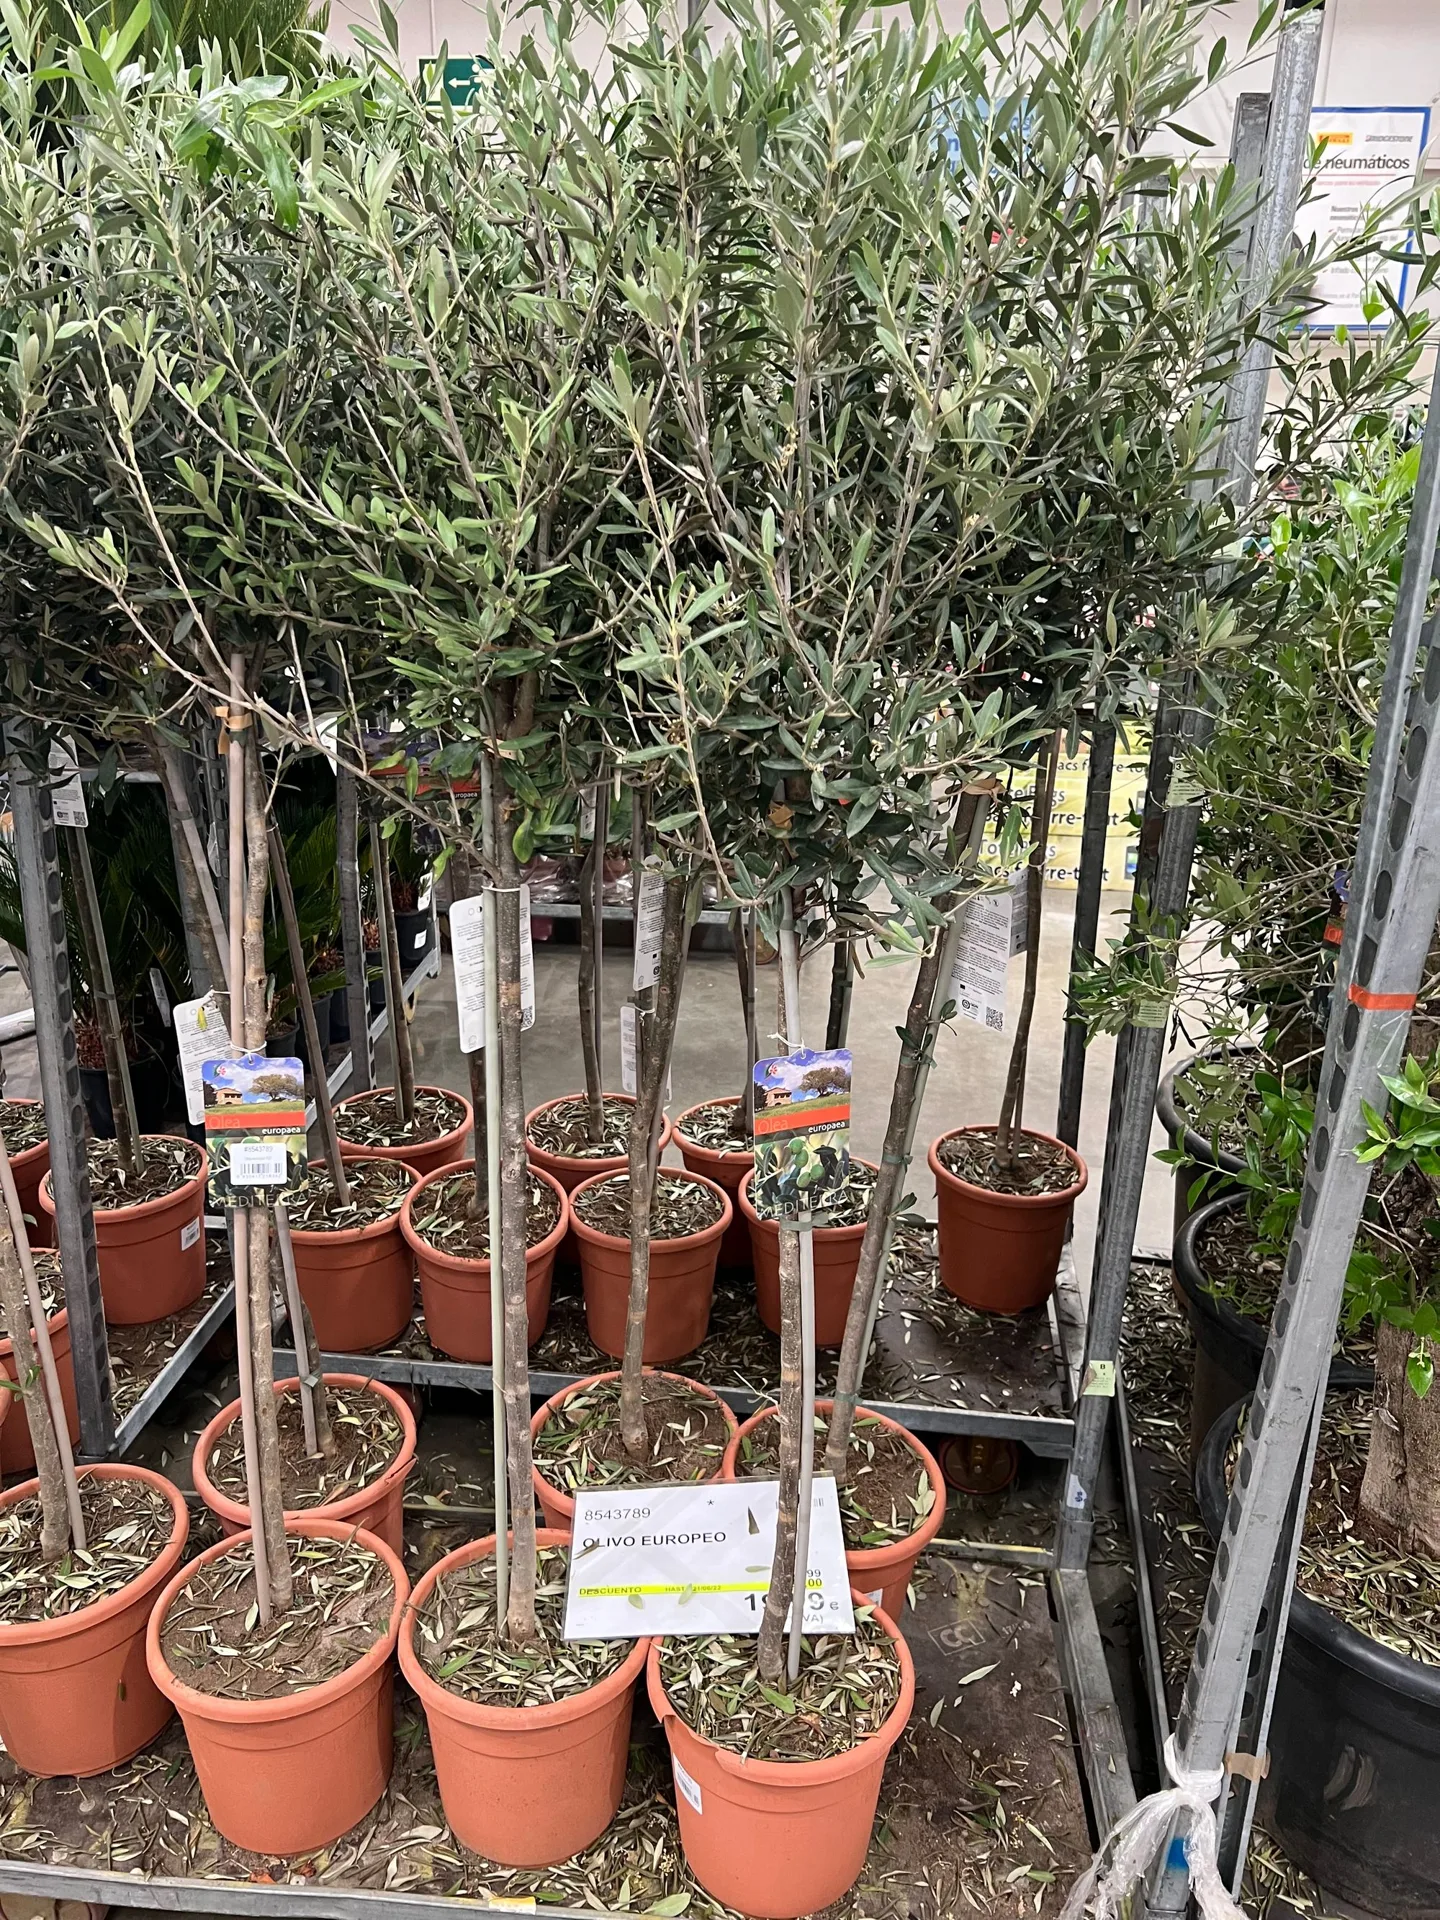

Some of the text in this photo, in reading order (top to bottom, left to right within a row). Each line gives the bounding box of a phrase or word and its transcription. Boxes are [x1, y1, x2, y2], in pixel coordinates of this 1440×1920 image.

[1325, 154, 1410, 170] neumáticos
[208, 1116, 241, 1129] Olea
[757, 1118, 789, 1134] Olea
[807, 1120, 846, 1133] europaea
[261, 1127, 301, 1135] europaea
[585, 1507, 651, 1521] 8543789
[582, 1531, 727, 1549] OLIVO EUROPEO
[579, 1586, 642, 1595] DESCUENTO
